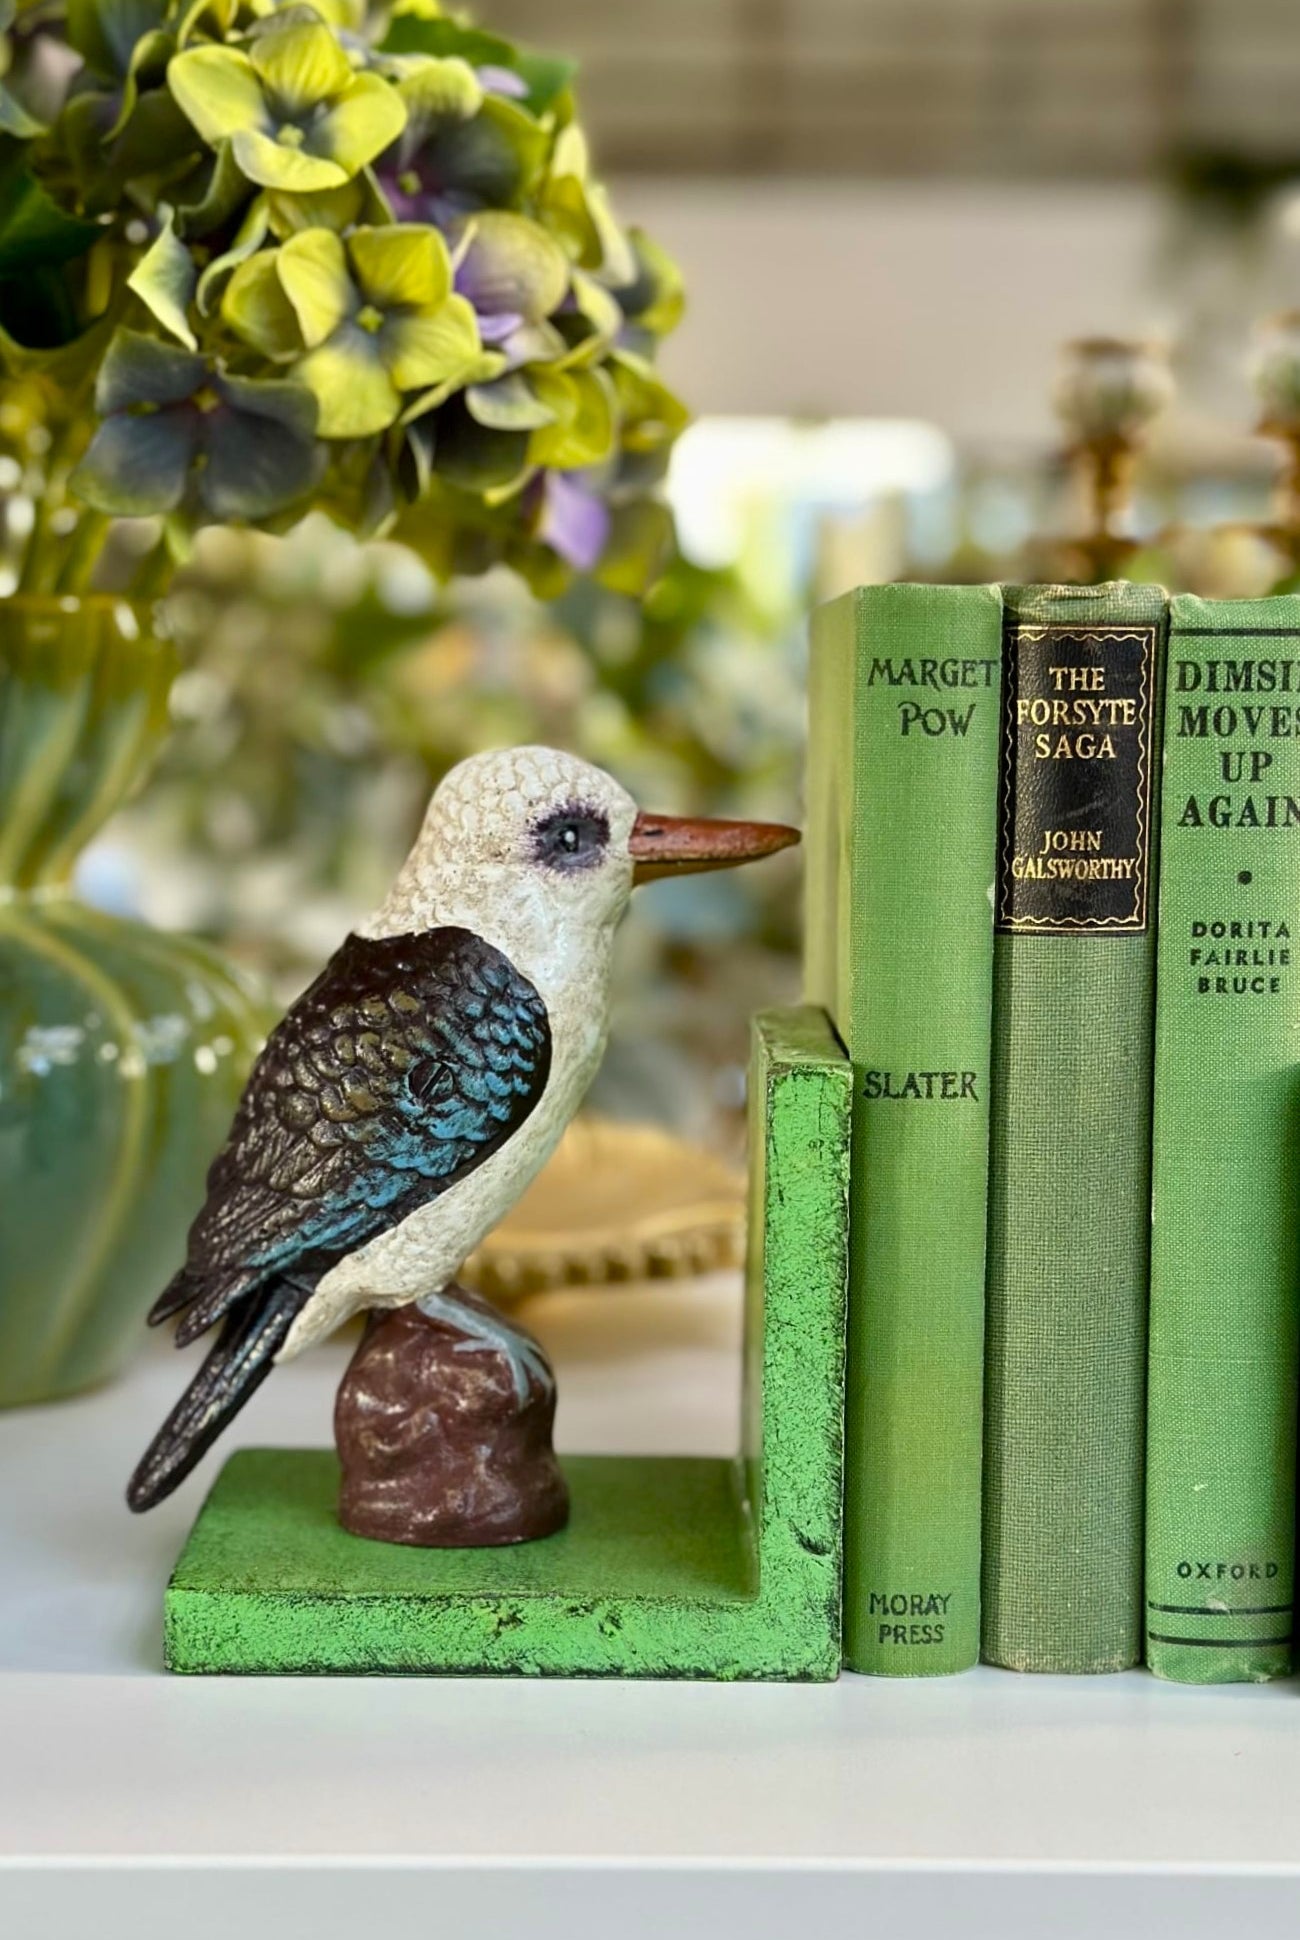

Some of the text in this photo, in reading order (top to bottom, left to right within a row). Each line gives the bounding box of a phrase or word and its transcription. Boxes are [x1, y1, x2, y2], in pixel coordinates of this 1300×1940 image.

[868, 658, 998, 692] MARGET
[1049, 667, 1105, 691] THE
[1175, 660, 1300, 692] DIMSI
[898, 701, 976, 737] POW
[1016, 699, 1136, 725] FORSYTE
[1177, 705, 1300, 737] MOVE
[1035, 734, 1116, 759] SAGA
[1220, 751, 1273, 783] UP
[1040, 830, 1103, 855] JOHN
[1011, 857, 1135, 880] GALSWORTHY
[1192, 921, 1290, 939] DORITA
[1190, 949, 1290, 966] FAIRLIE
[1198, 977, 1280, 994] BRUCE
[863, 1071, 979, 1102] SLATER
[1177, 1561, 1279, 1580] OXFORD
[869, 1591, 953, 1616] MORAY
[878, 1623, 946, 1645] PRESS
